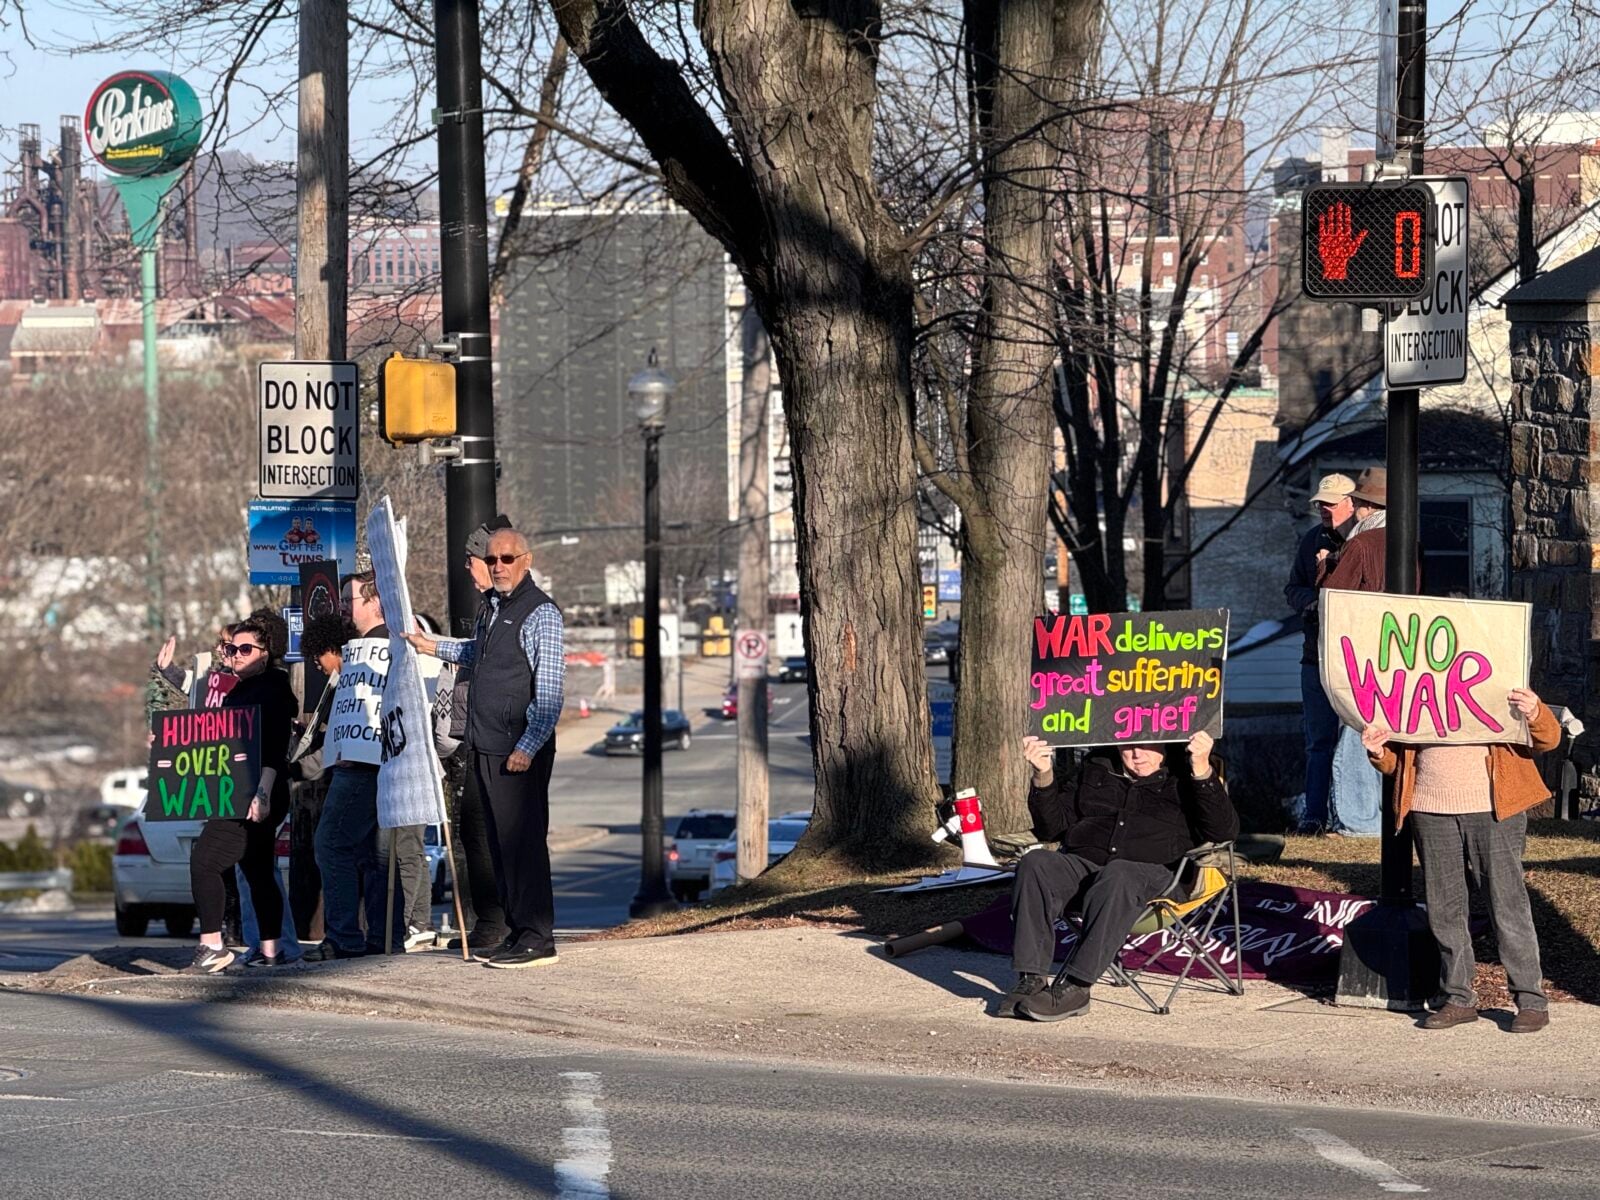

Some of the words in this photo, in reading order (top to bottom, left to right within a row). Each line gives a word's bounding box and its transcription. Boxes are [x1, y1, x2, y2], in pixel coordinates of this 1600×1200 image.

[90, 83, 174, 154] Perkins
[1395, 210, 1421, 278] 0
[1390, 270, 1463, 316] OCK
[1391, 328, 1463, 363] INTERSECTION
[265, 380, 297, 410] DO
[306, 381, 354, 411] NOT
[267, 425, 352, 455] BLOCK
[263, 465, 355, 486] INTERSECTION
[369, 646, 391, 662] FO
[1034, 613, 1115, 659] WAR
[1115, 619, 1223, 652] delivers
[1378, 611, 1457, 672] NO
[1030, 659, 1105, 710] great
[1106, 657, 1220, 699] suffering
[1340, 635, 1504, 738] WAR
[163, 707, 256, 748] HUMANITY
[335, 698, 366, 716] FIGHT
[1042, 698, 1092, 734] and
[1114, 695, 1198, 739] grief
[333, 724, 382, 743] DEMOCR
[175, 744, 231, 776] OVER
[158, 776, 236, 818] WAR
